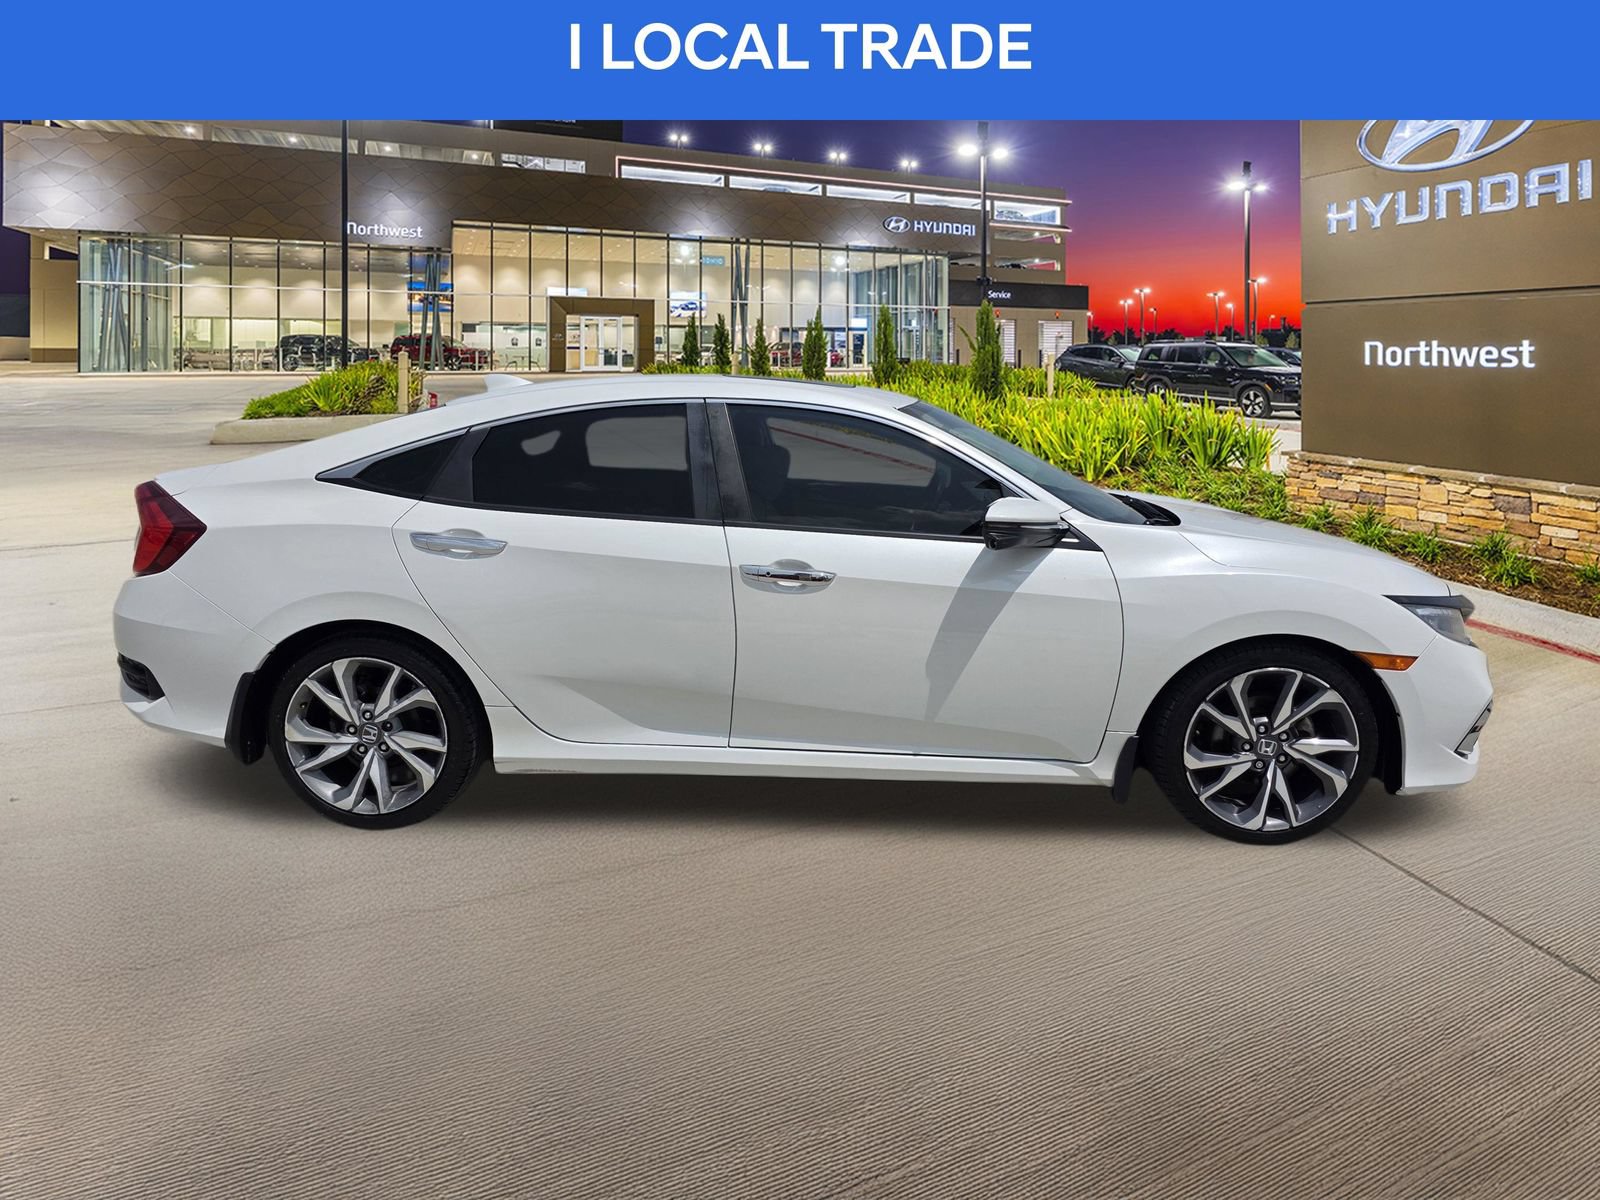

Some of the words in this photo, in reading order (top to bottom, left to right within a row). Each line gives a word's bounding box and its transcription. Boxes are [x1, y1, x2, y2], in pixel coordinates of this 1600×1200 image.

[1326, 159, 1593, 235] HYUNDAI
[347, 221, 423, 238] Northwest
[913, 220, 976, 236] HYUNDAI
[988, 290, 1011, 299] Service
[1364, 340, 1536, 369] Northwest
